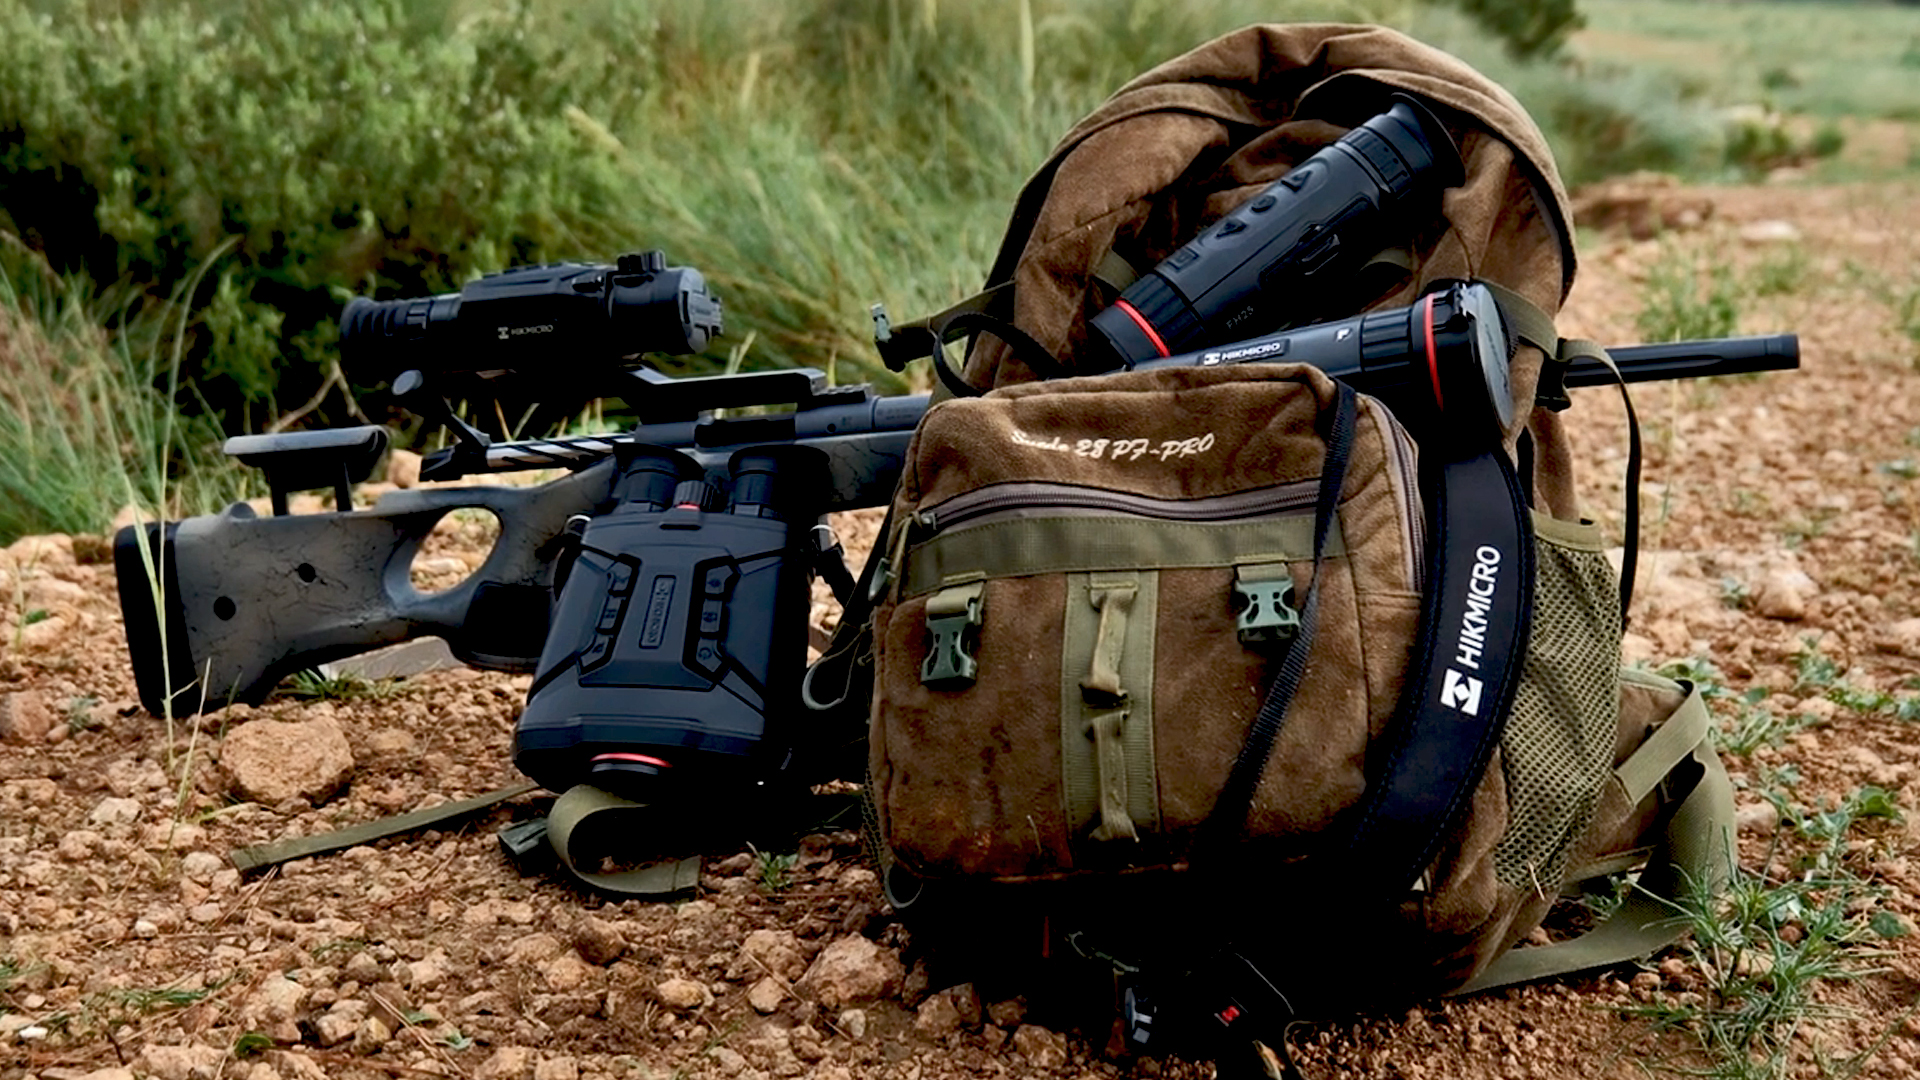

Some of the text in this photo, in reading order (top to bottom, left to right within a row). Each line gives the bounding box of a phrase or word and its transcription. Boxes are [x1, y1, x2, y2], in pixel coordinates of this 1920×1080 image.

[1222, 342, 1281, 361] HIKMICRO
[1074, 438, 1110, 459] 28
[1455, 545, 1501, 670] HIKMICRO
